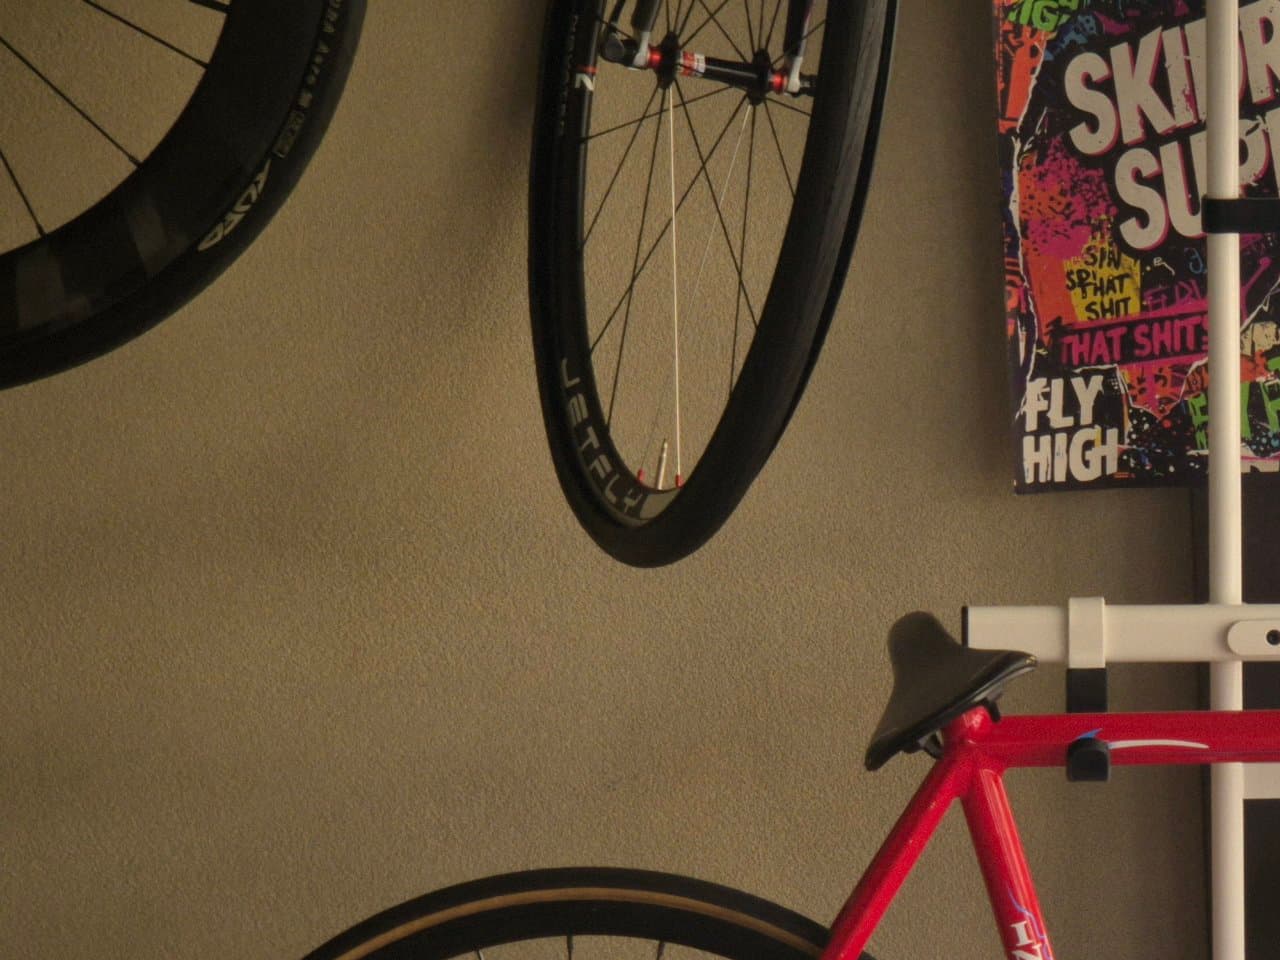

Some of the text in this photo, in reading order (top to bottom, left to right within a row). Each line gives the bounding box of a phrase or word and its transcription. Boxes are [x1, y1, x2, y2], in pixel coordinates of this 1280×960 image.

[1085, 296, 1131, 320] SHIT
[1061, 326, 1127, 365] THAT
[1025, 376, 1105, 432] FLY
[561, 357, 643, 513] JETFLY
[1022, 427, 1119, 484] HIGH
